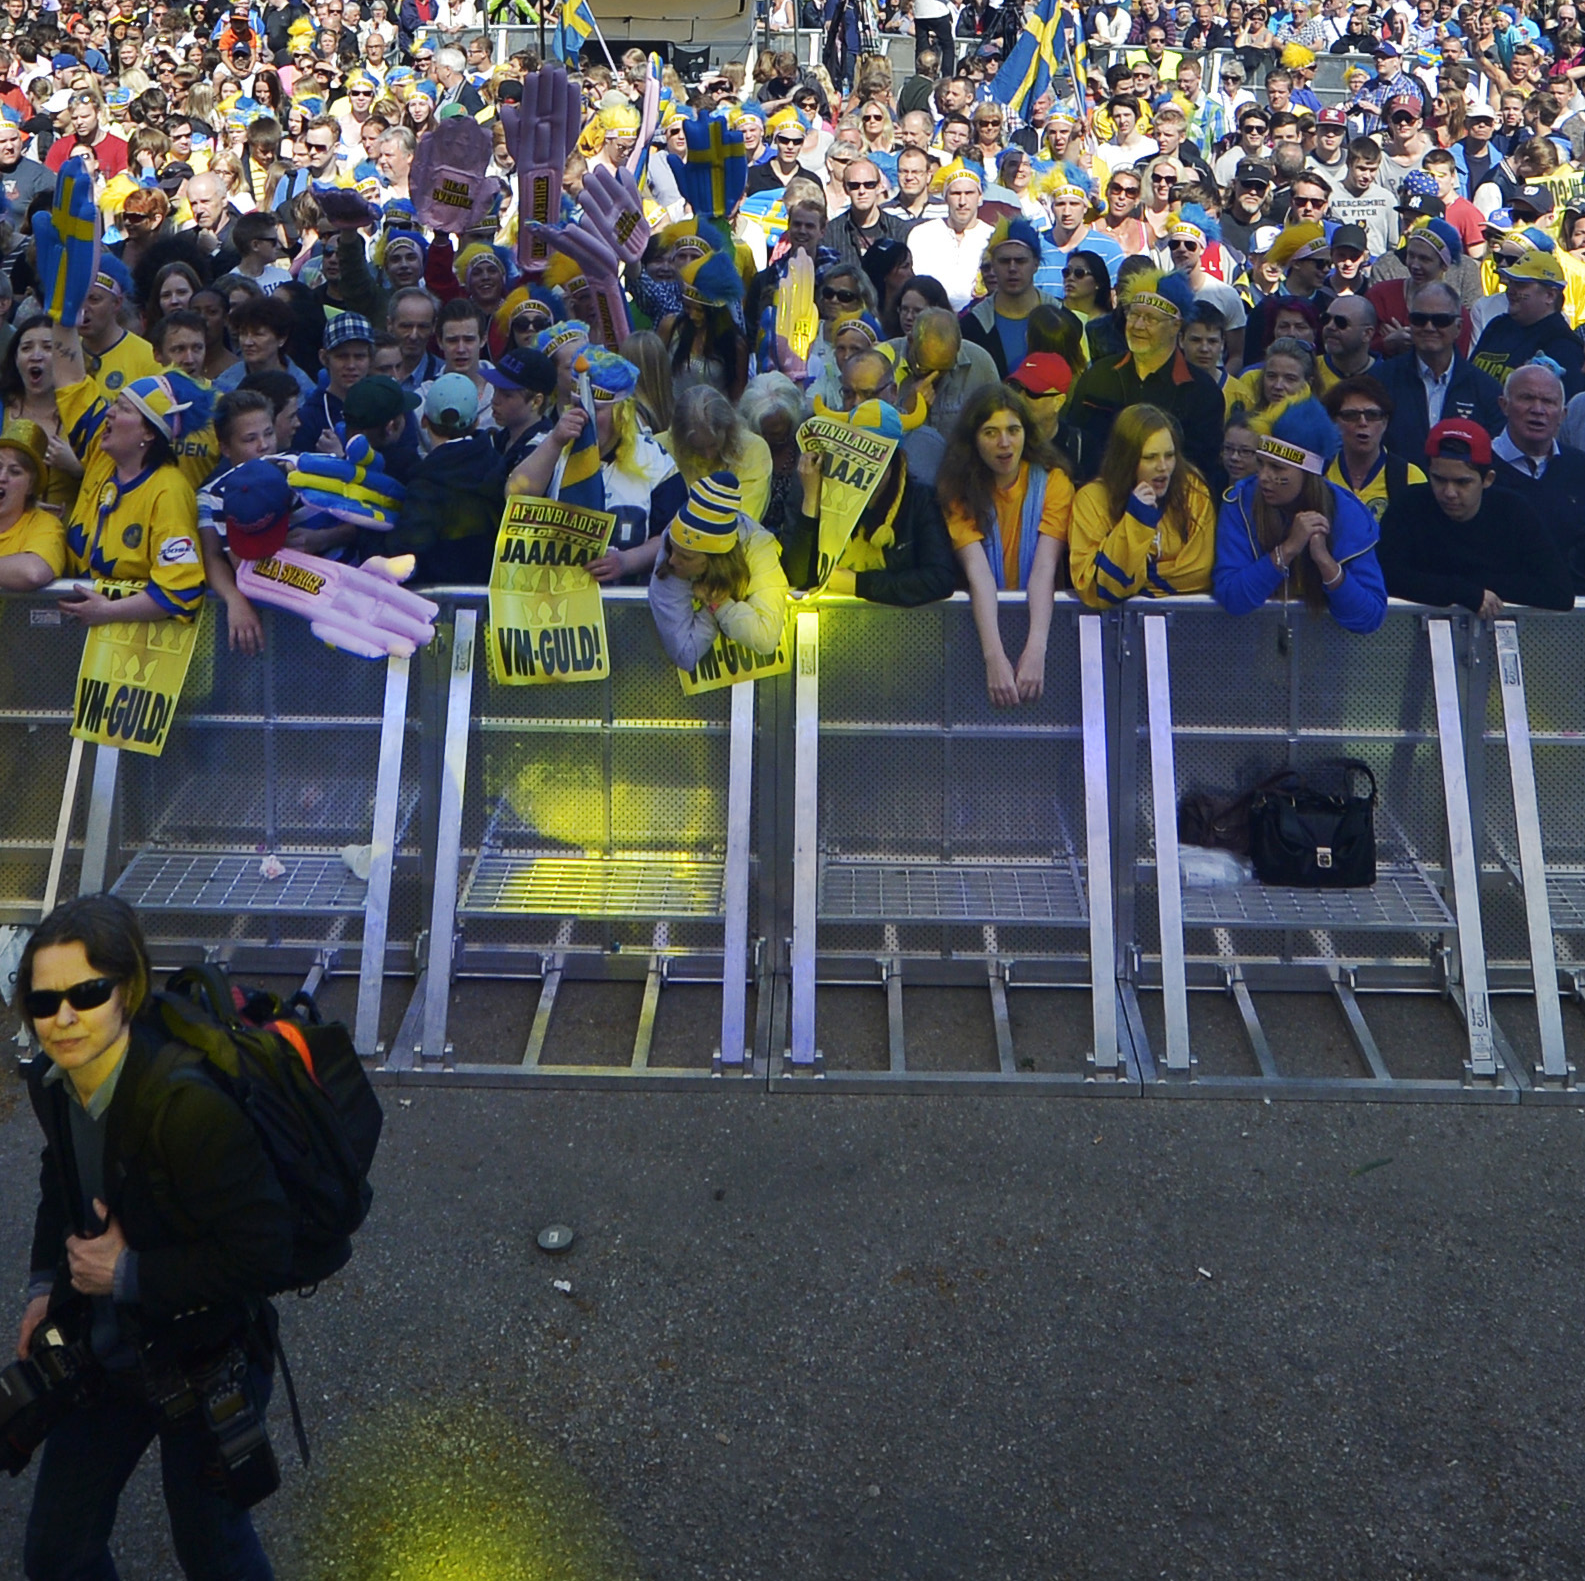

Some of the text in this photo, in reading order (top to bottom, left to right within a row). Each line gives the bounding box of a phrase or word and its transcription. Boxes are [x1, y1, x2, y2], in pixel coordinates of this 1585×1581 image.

[432, 188, 474, 210] SVERIGE
[443, 178, 470, 196] HEJA
[1330, 199, 1386, 208] ABERCROMBIE
[1341, 208, 1377, 217] & FITCH
[511, 504, 607, 536] AFTONBLADET
[252, 557, 327, 595] HEJA SVERIGE
[498, 624, 604, 678] VM-GULD!
[78, 678, 173, 747] VM-GULD!
